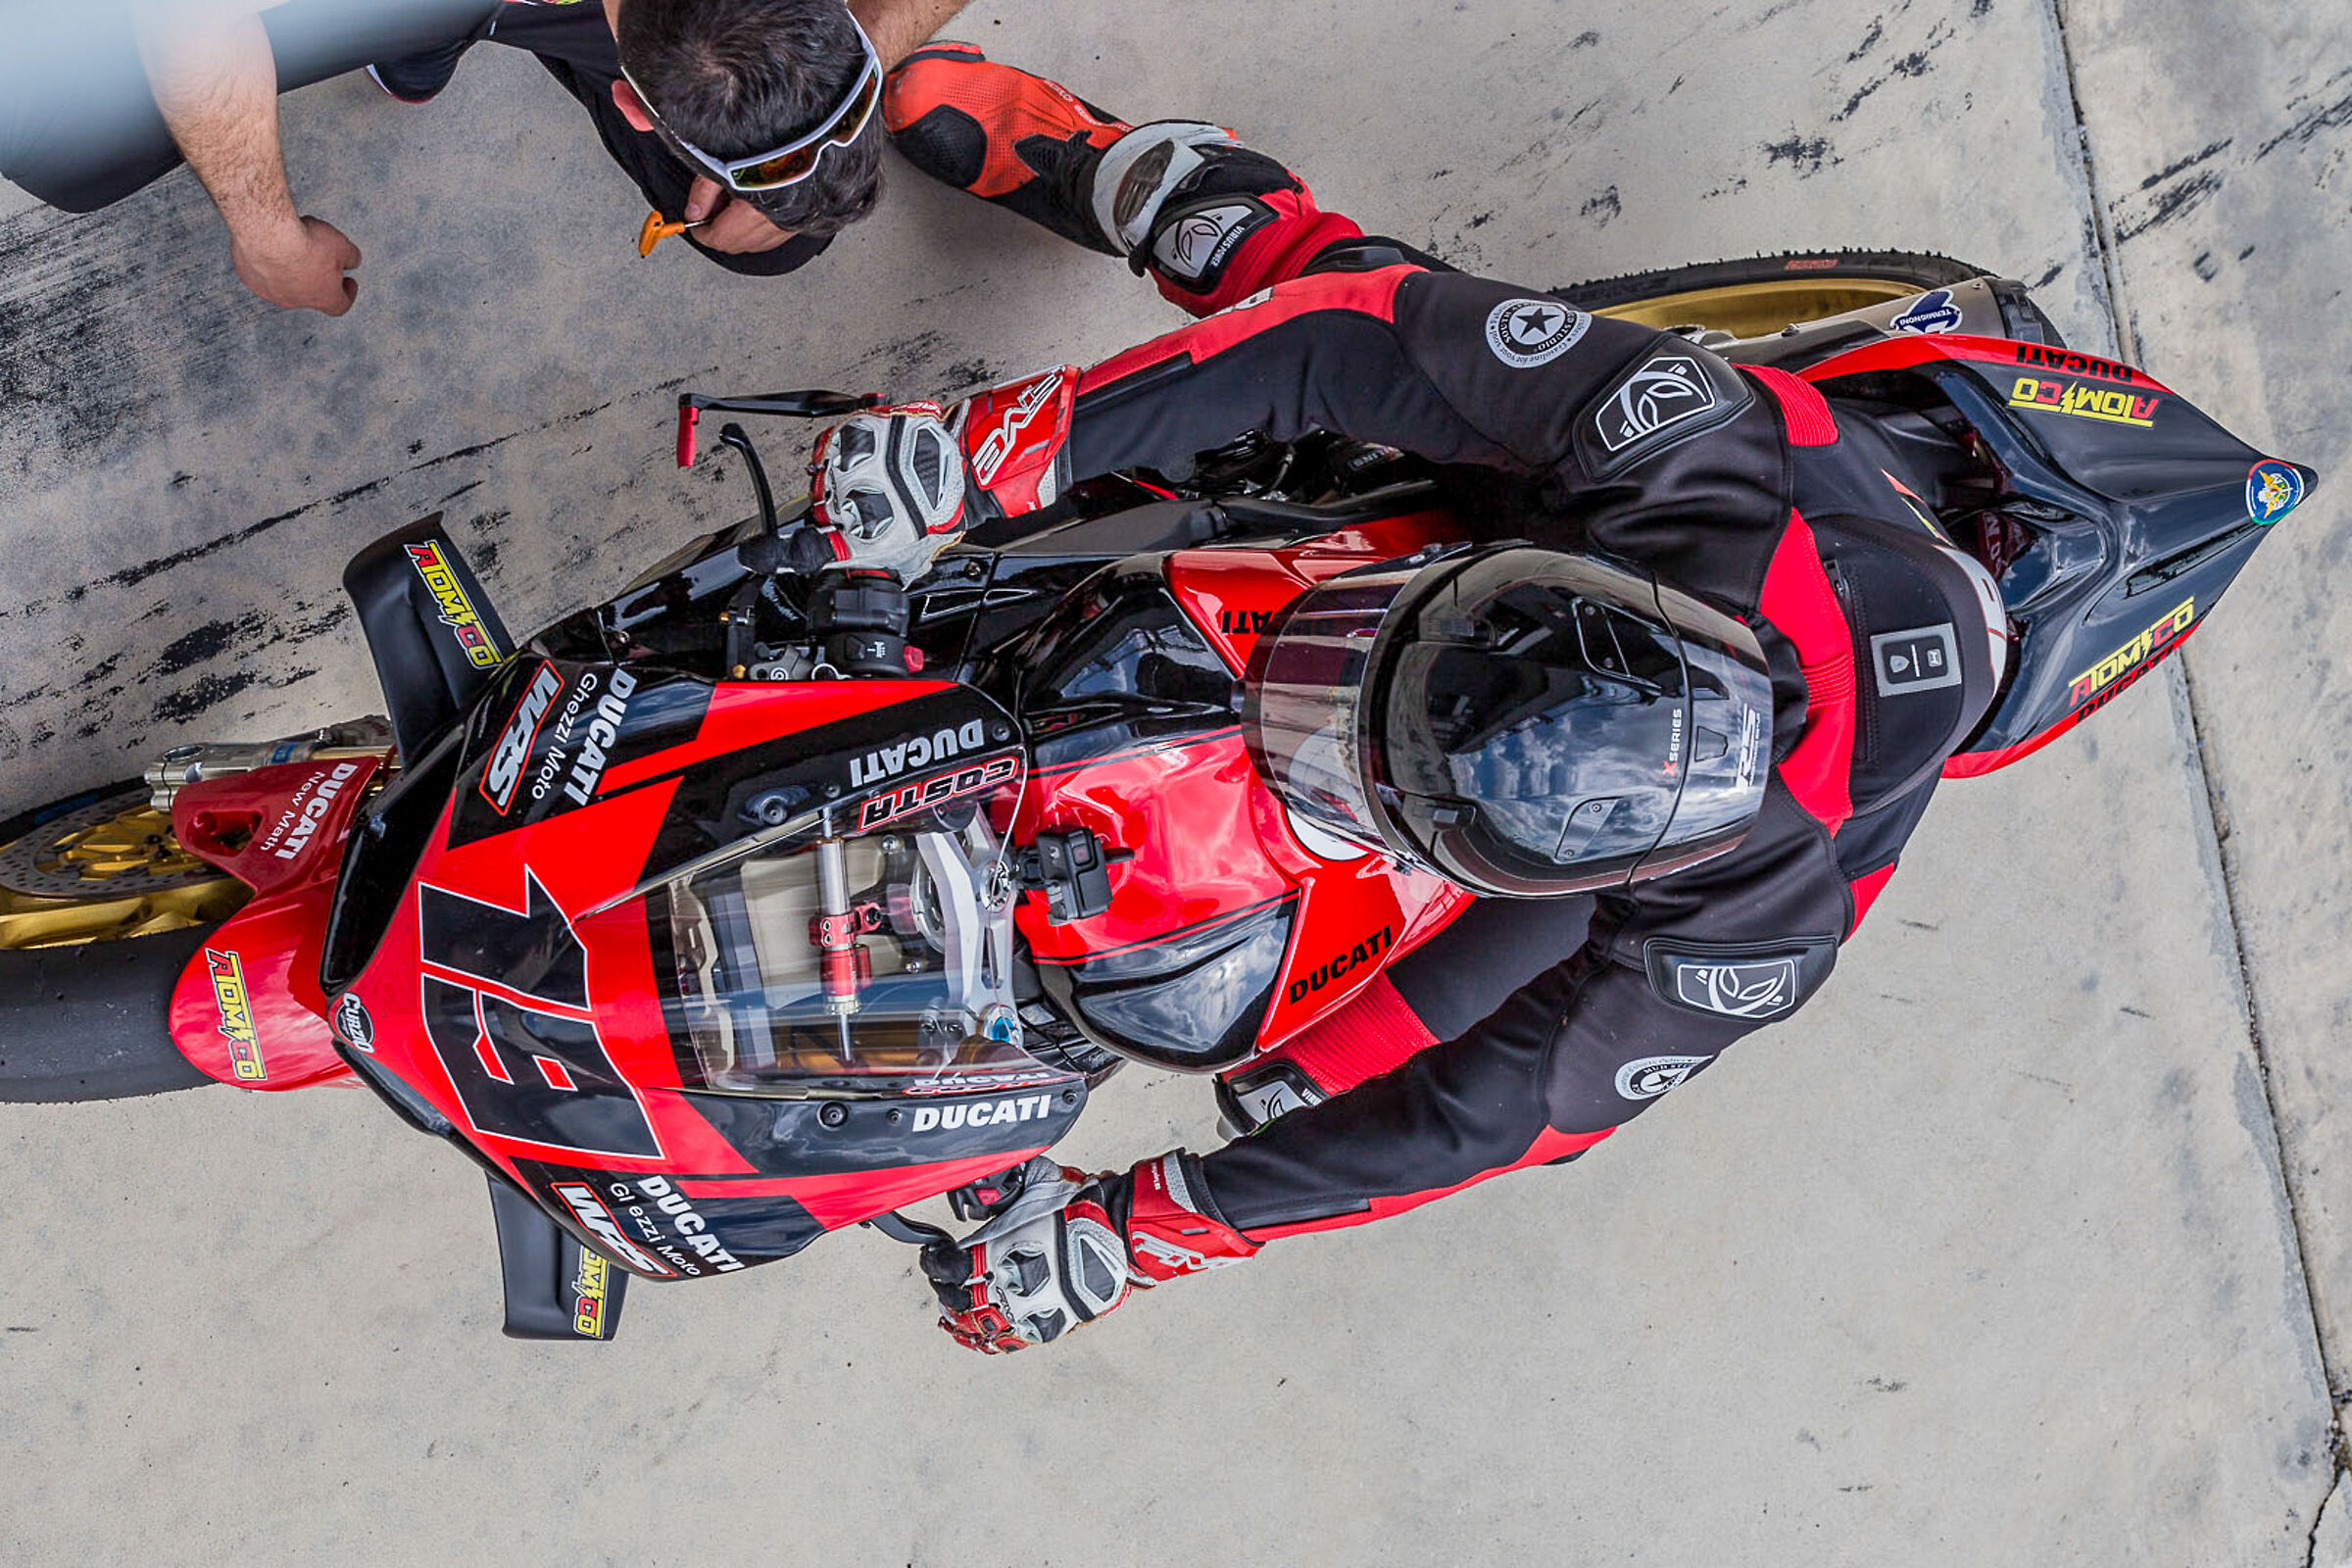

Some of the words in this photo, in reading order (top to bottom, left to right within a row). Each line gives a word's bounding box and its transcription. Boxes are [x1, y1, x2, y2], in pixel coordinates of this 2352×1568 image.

[2016, 345, 2132, 383] DUCATI
[1221, 611, 1275, 634] ATI
[489, 667, 560, 808] WRS
[548, 672, 600, 744] Ghezzi
[564, 667, 637, 807] DUCATI
[1669, 708, 1683, 762] SERIES
[531, 745, 567, 801] Moto
[850, 718, 984, 787] DUCATI
[273, 762, 359, 860] DUCATI
[858, 756, 1019, 833] COSTA
[260, 810, 297, 851] Math
[1290, 925, 1393, 1004] DUCATI
[343, 992, 375, 1054] CURZIO
[912, 1094, 1052, 1132] DUCATI
[637, 1175, 745, 1272] DUCATI
[571, 1246, 611, 1340] OMICO
[657, 1244, 701, 1276] Moto
